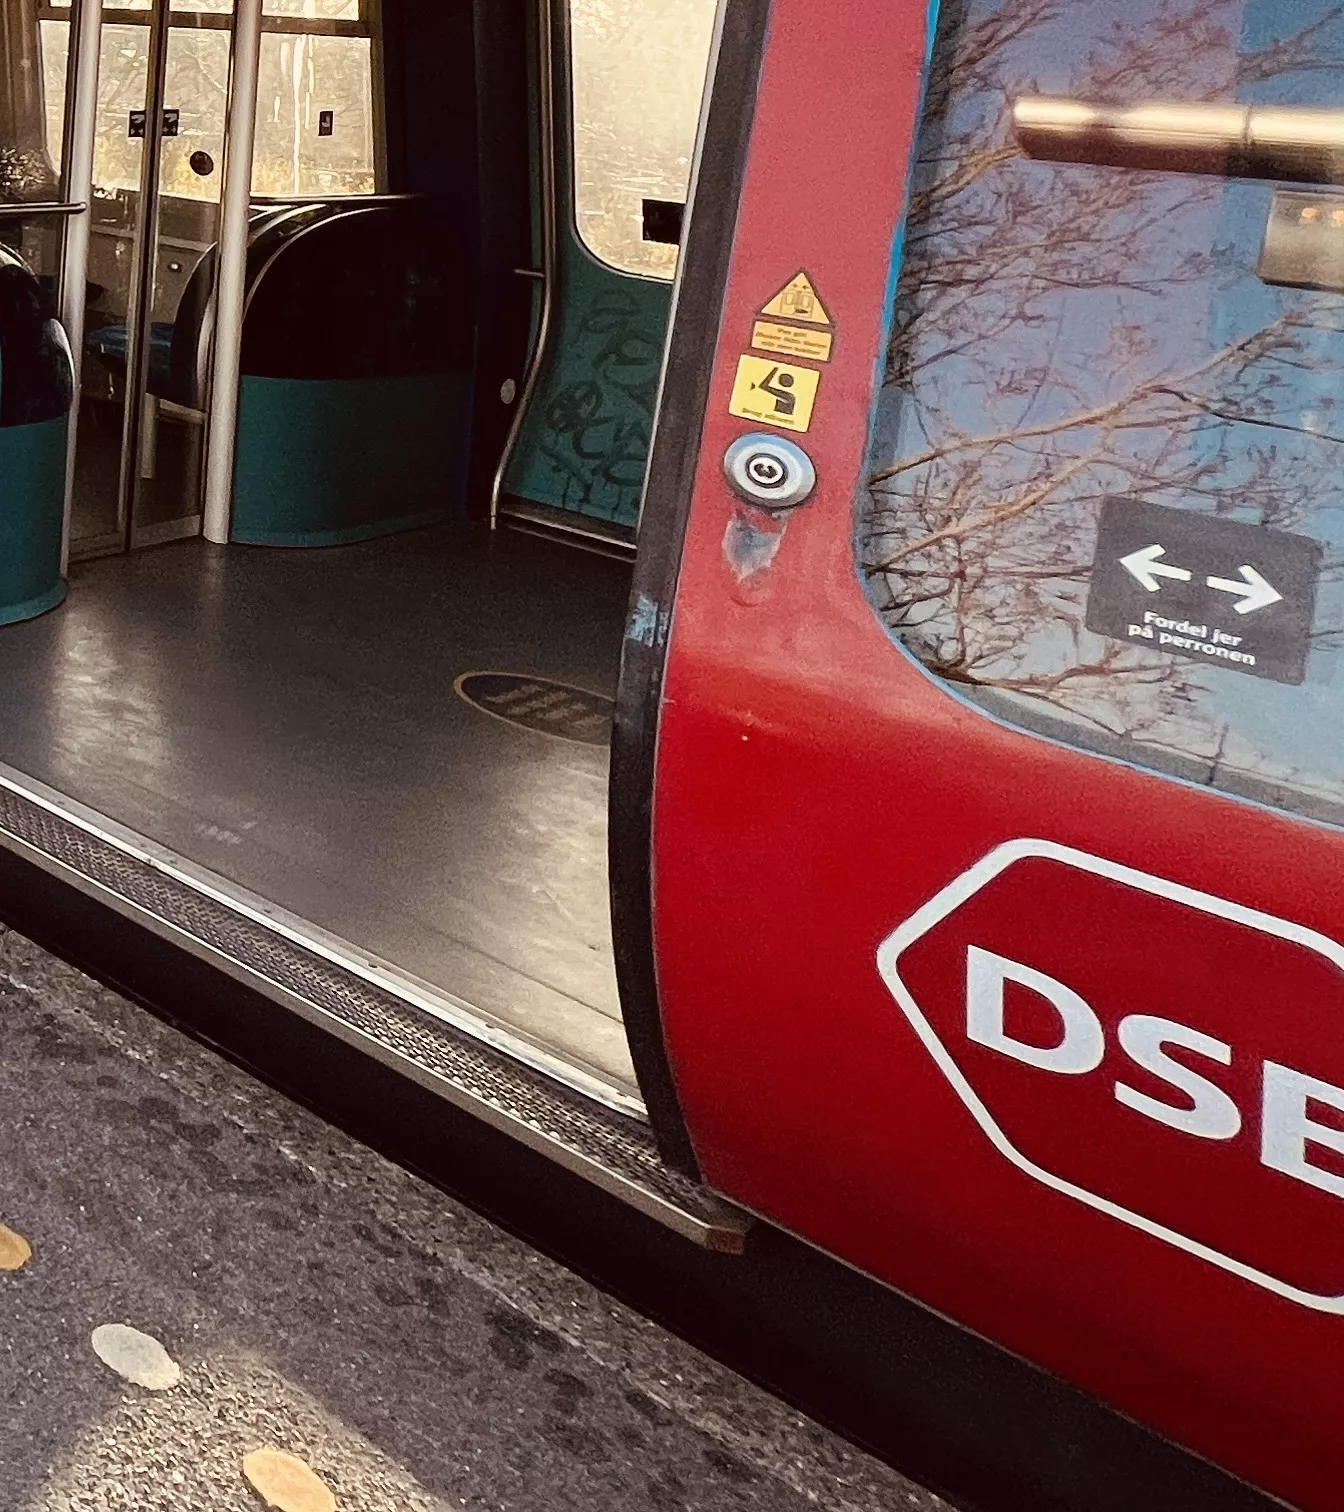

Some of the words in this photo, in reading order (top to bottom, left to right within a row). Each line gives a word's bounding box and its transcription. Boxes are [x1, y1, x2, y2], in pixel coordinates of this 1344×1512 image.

[1128, 624, 1153, 639] på
[1160, 632, 1255, 665] perronen
[1144, 611, 1207, 638] Fordel
[1211, 629, 1243, 646] jer
